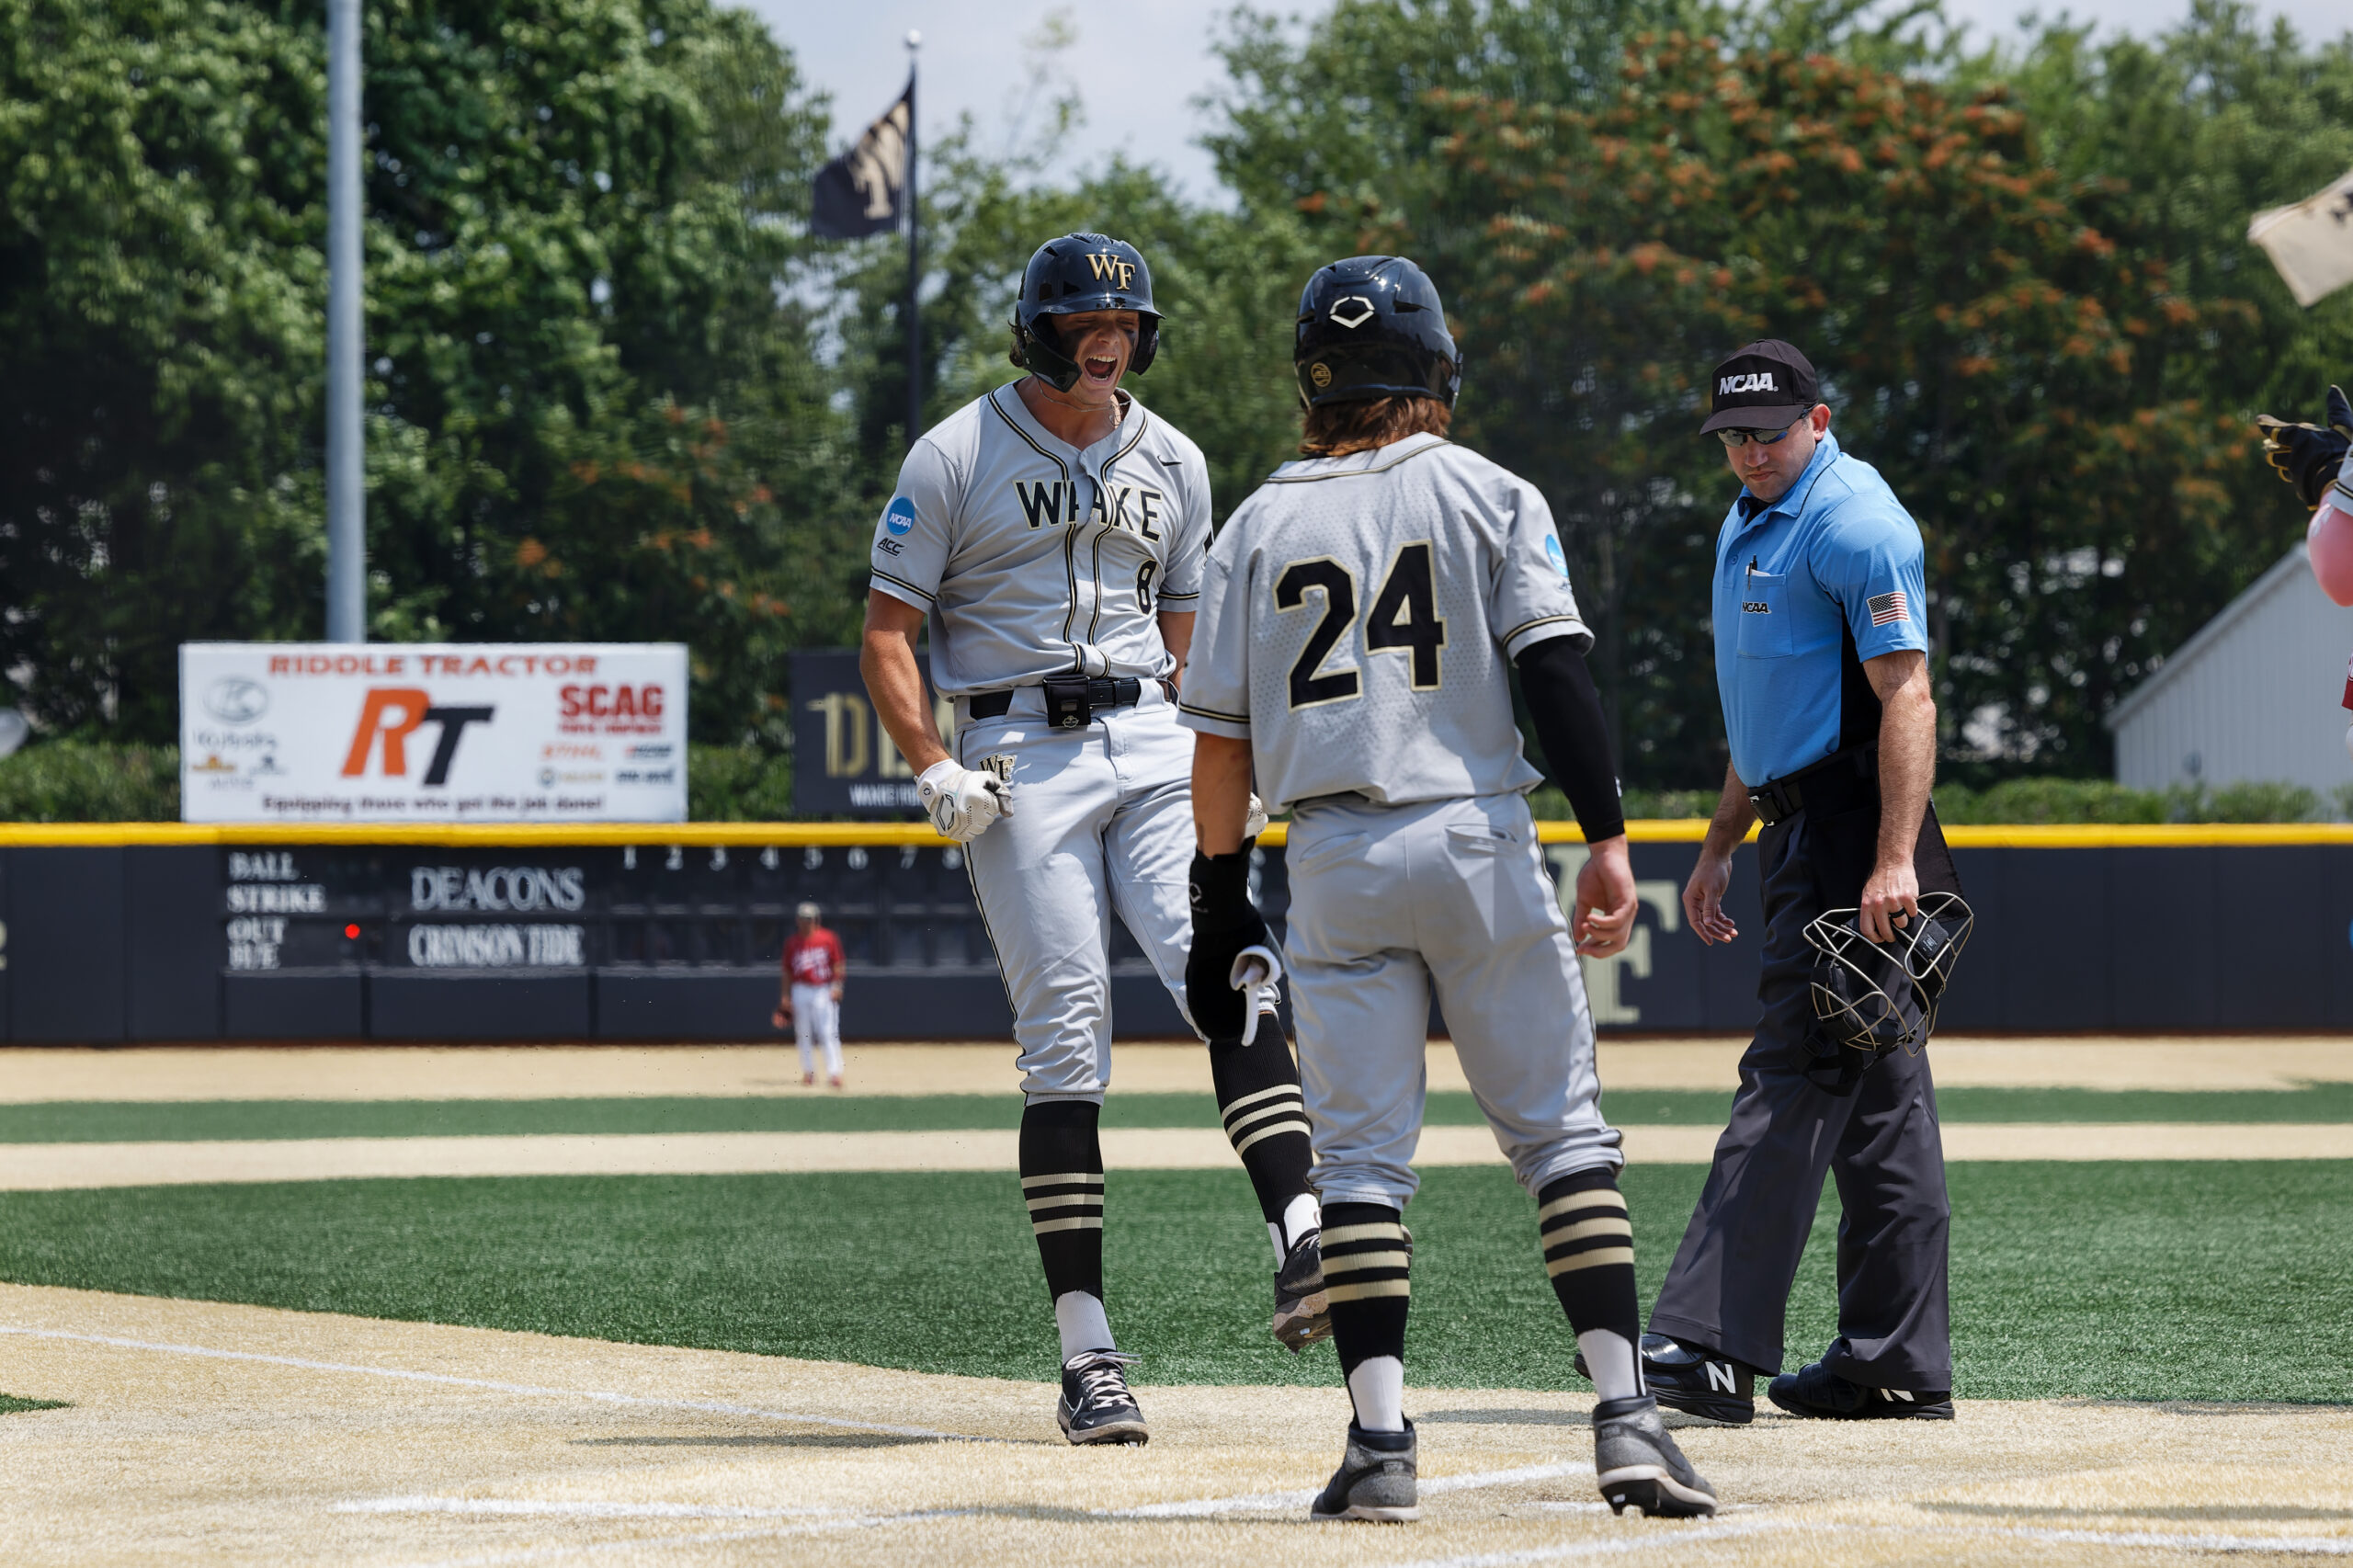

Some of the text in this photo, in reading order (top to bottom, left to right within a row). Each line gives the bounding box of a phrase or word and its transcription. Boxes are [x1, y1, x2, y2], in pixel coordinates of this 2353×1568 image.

[1086, 254, 1136, 290] WF
[1719, 372, 1775, 396] NCAA
[889, 512, 912, 528] NCAA
[877, 537, 904, 555] ACC
[1134, 556, 1158, 616] 8
[1742, 601, 1769, 614] NCAA
[1273, 540, 1449, 713] 24
[268, 655, 597, 676] RIDDLE TRACTOR
[560, 685, 664, 718] SCAG
[340, 687, 496, 787] RT
[979, 752, 1017, 782] WF
[229, 852, 298, 881] BALL
[665, 845, 683, 870] 2
[227, 884, 325, 913] STRIKE
[411, 866, 585, 911] DEACONS
[227, 915, 286, 944] OUT
[409, 924, 585, 967] CRIMSON TIDE
[1705, 1361, 1736, 1393] N
